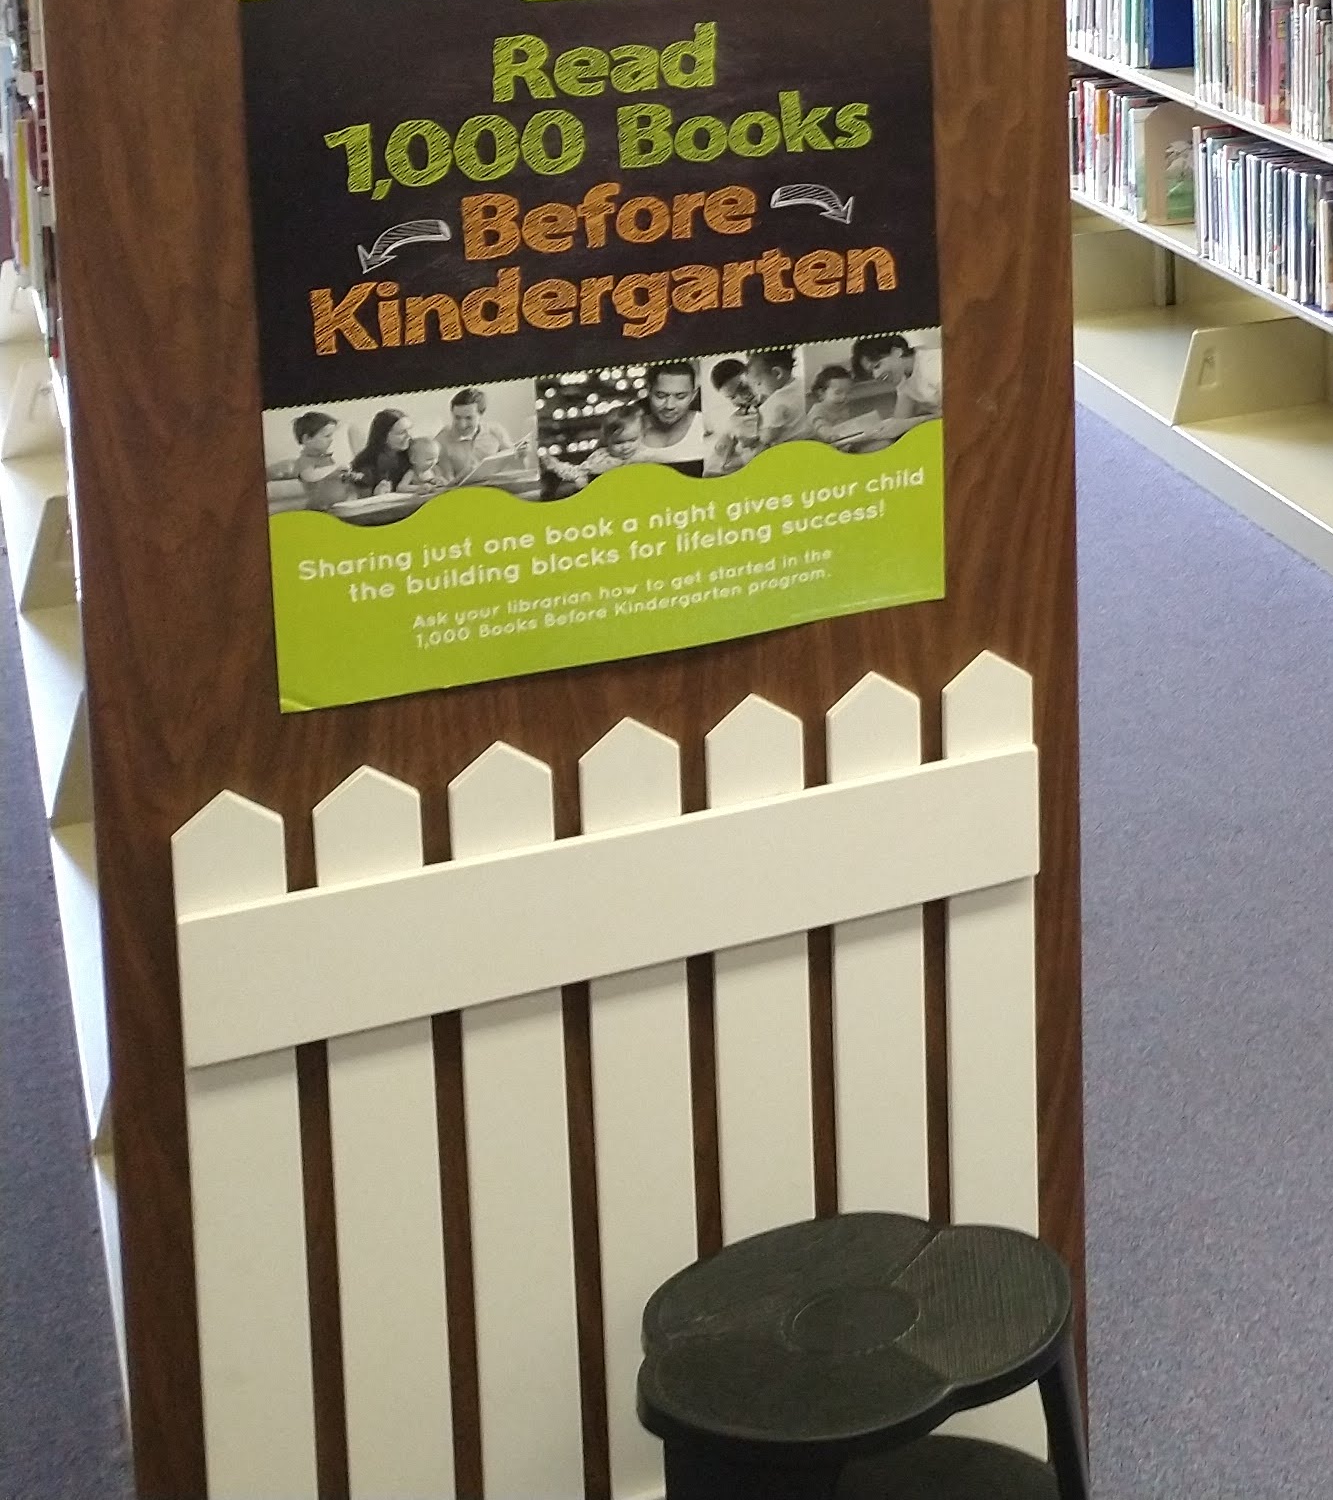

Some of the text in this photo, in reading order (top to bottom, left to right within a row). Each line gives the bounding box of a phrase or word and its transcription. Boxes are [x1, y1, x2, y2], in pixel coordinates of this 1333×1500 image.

[491, 21, 718, 103] Read
[323, 90, 874, 201] 1,000 Books
[461, 182, 758, 262] Before
[310, 245, 898, 357] Kindergarten
[298, 467, 925, 580] Sharing just one book a night gives your child
[349, 498, 886, 603] the building blocks for lifelong success!
[412, 547, 833, 630] Ask your librarian how to get started in the
[415, 567, 833, 651] 1,000 Books Before Kindergarten program.
